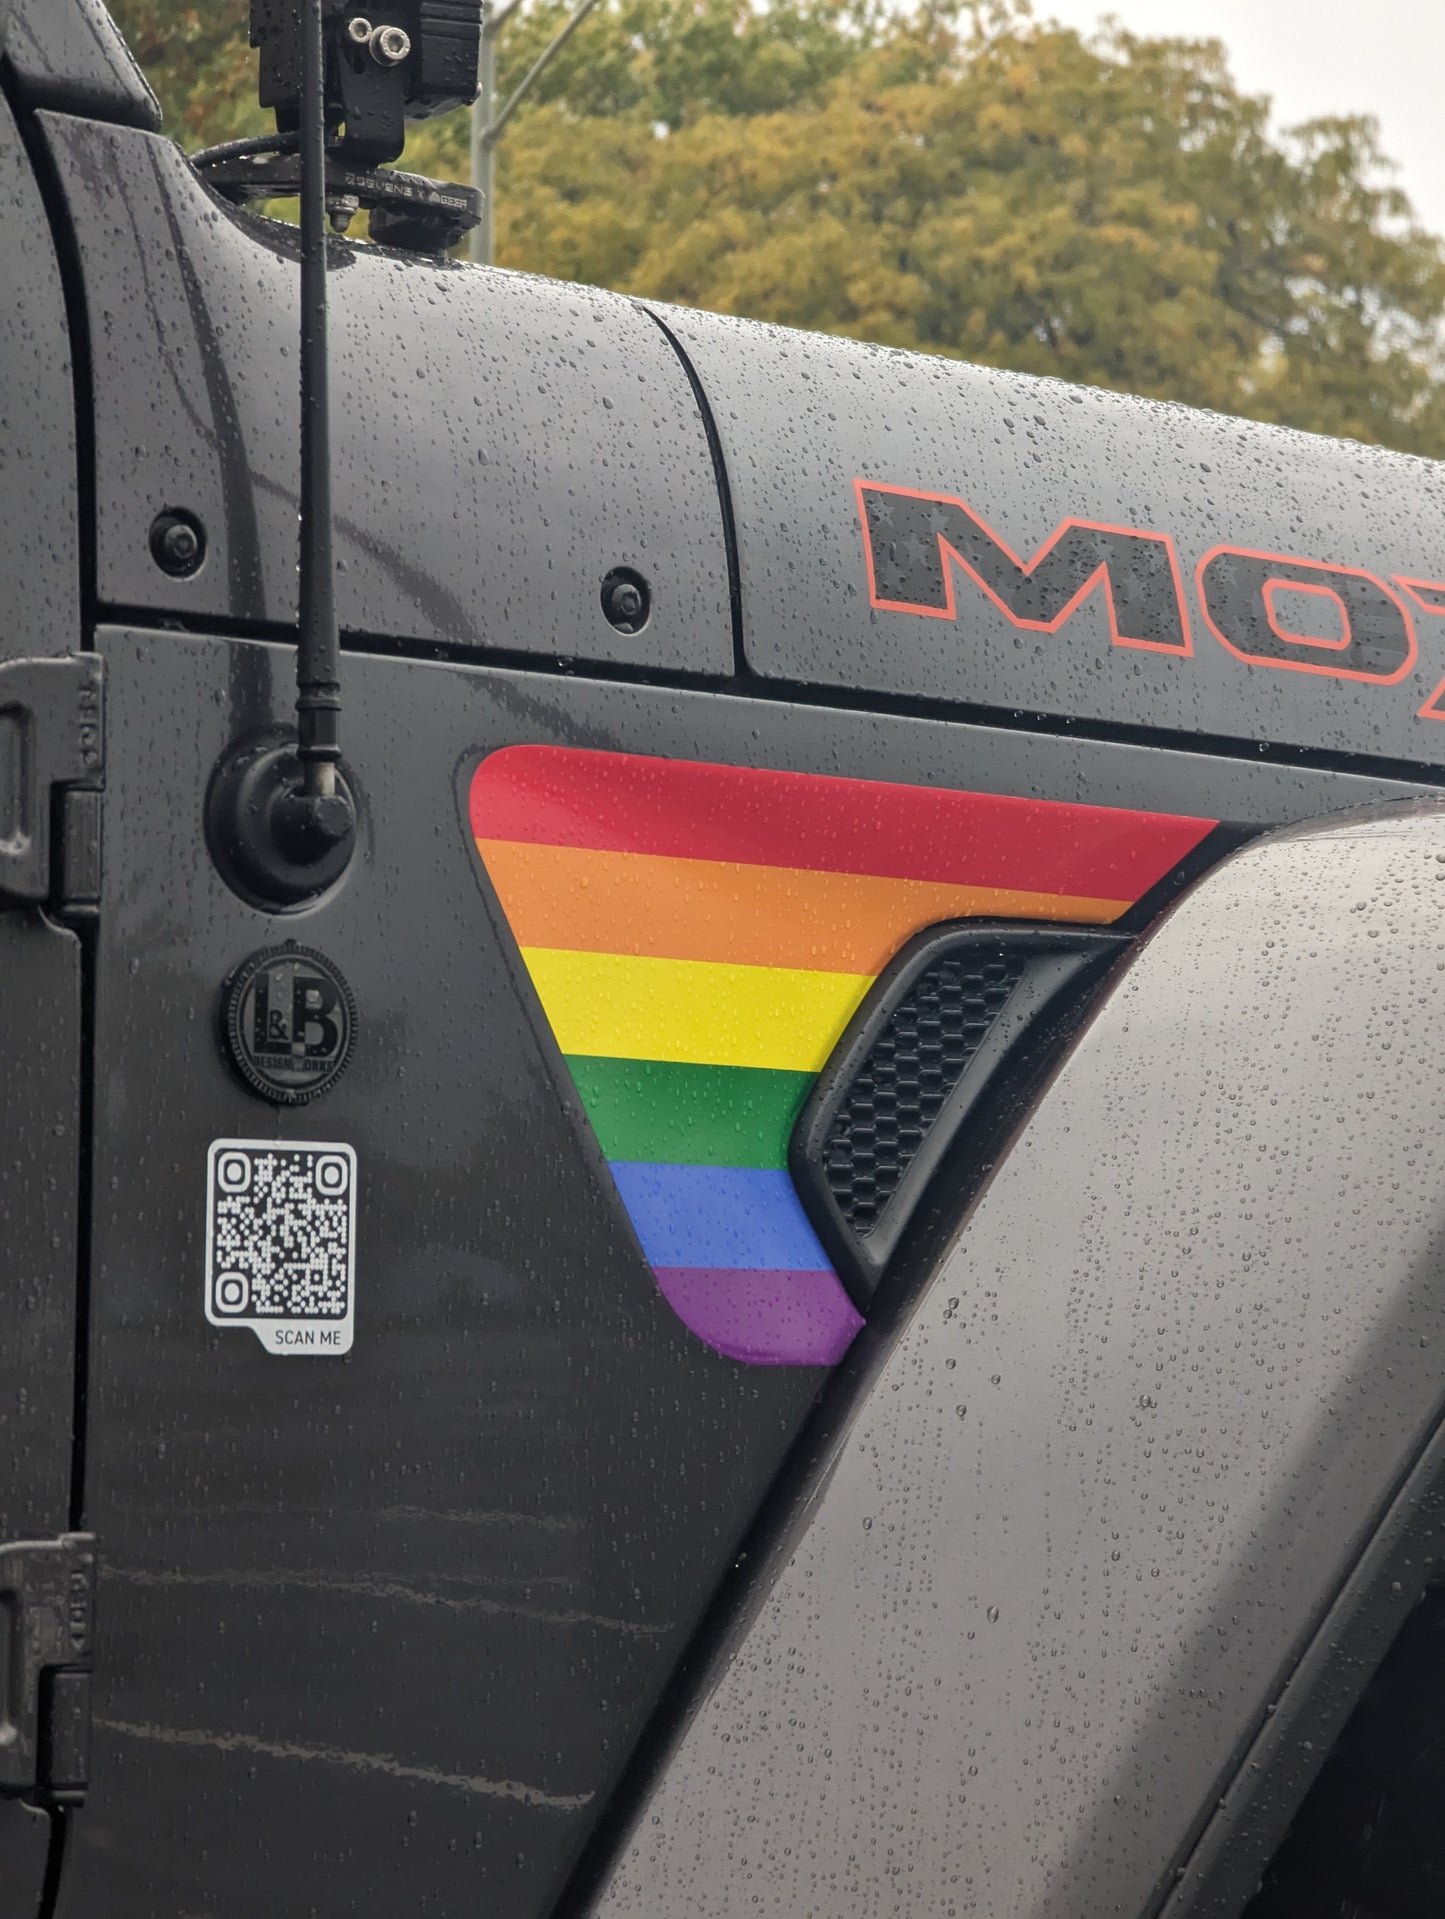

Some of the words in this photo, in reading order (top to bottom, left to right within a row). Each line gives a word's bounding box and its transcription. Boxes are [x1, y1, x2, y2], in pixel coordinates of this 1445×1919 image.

[253, 972, 338, 1057] L&B
[275, 1329, 314, 1345] SCAN
[320, 1330, 341, 1345] ME
